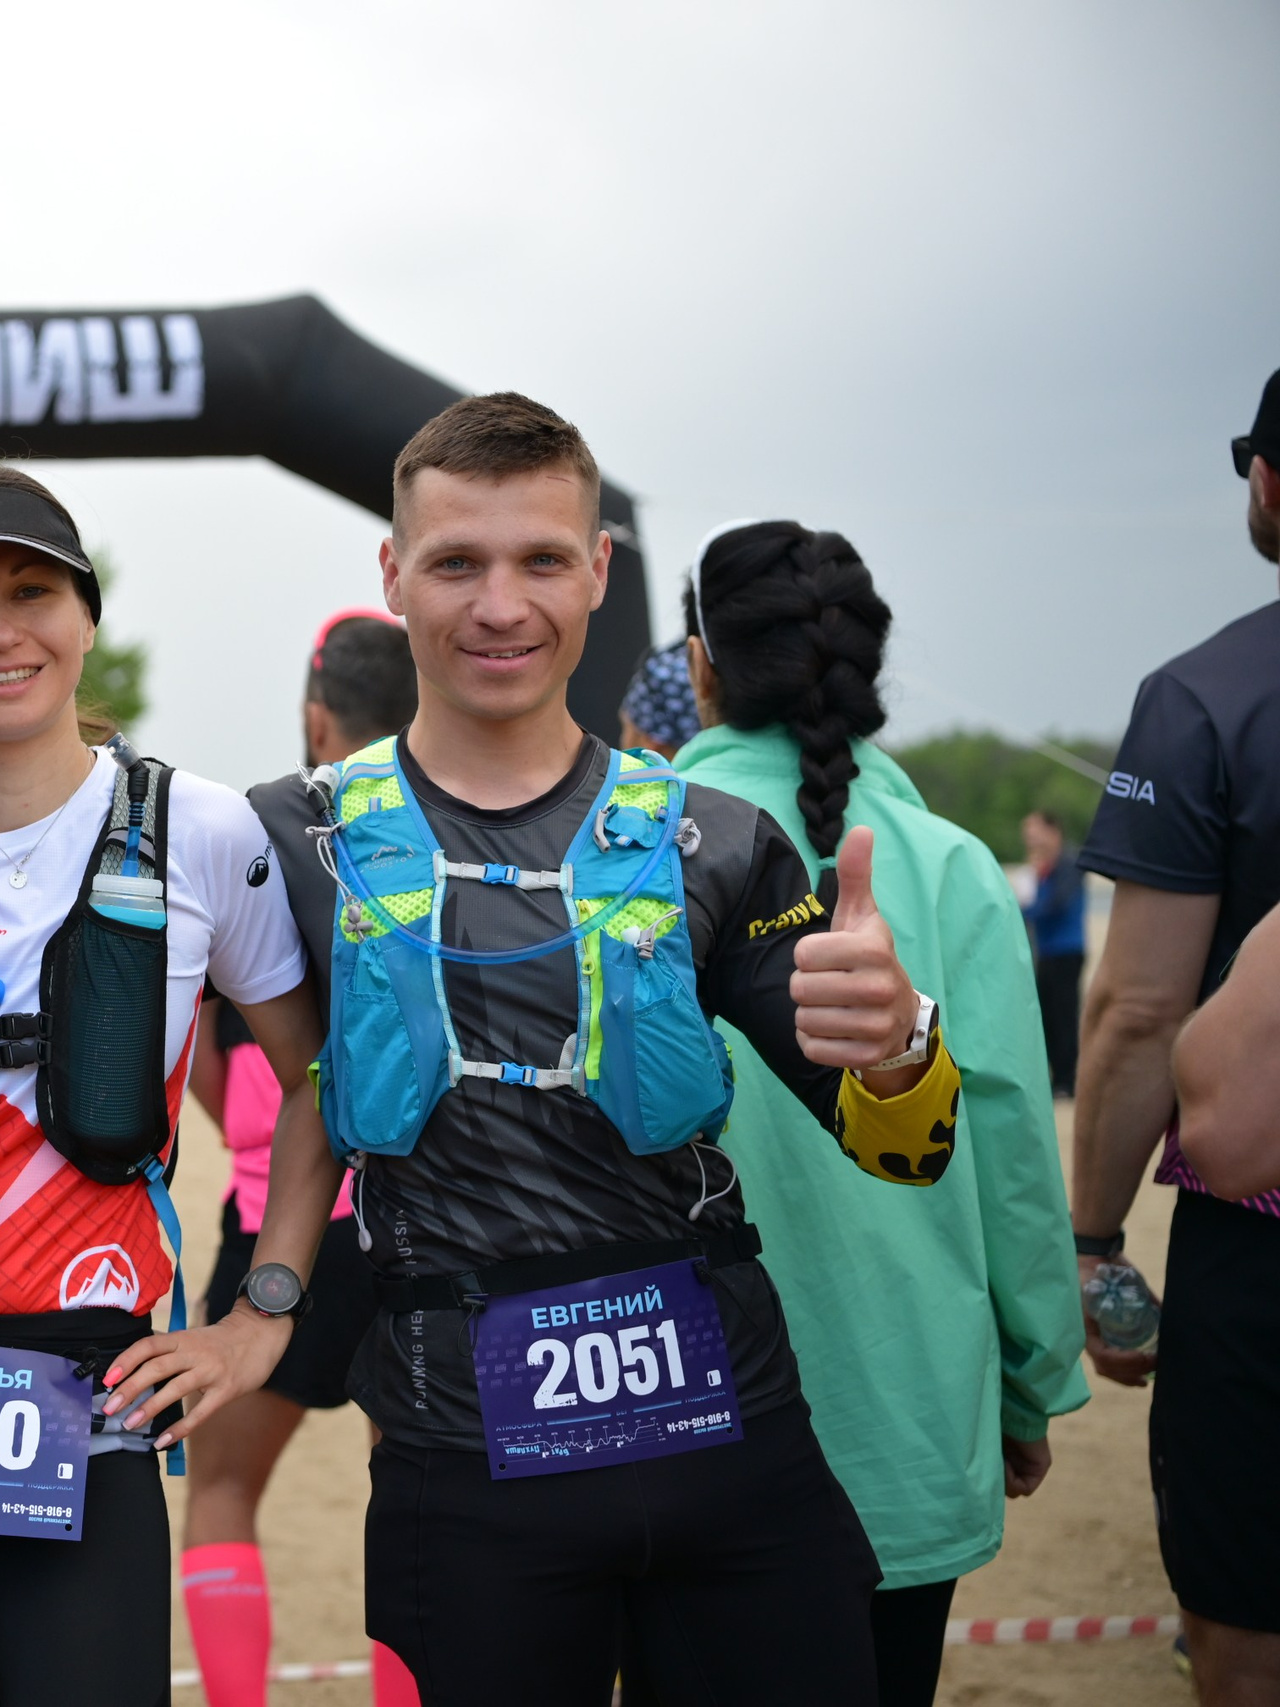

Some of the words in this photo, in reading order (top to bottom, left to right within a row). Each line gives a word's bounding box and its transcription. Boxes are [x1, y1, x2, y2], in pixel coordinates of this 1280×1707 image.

[1106, 770, 1156, 806] SIA
[531, 1284, 663, 1329] ЕВГЕНИЙ
[526, 1318, 686, 1410] 2051
[2, 1502, 72, 1518] 8-918-515-43-14
